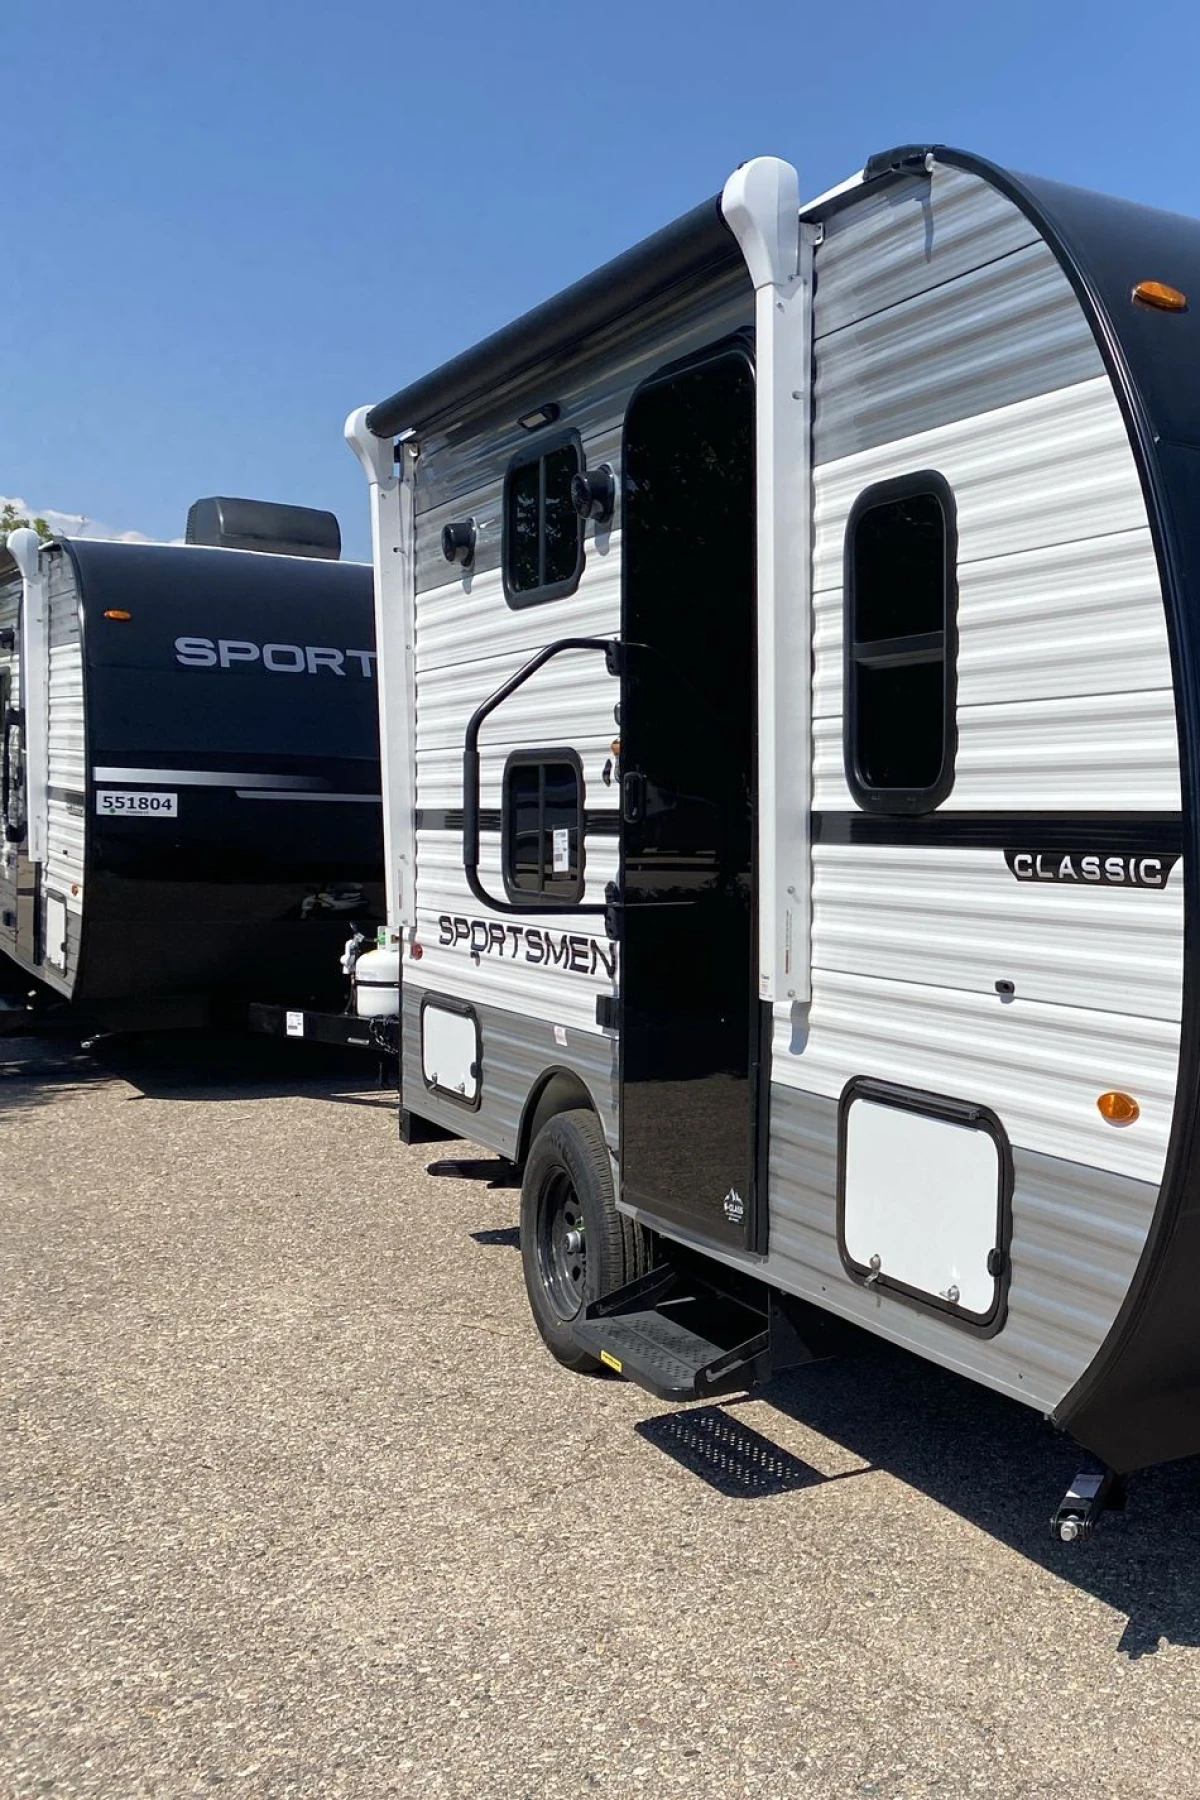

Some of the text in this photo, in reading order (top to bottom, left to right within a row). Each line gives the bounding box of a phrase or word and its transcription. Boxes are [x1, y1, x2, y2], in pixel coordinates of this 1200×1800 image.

[174, 637, 377, 678] SPORT
[102, 796, 172, 811] 551804
[1013, 854, 1162, 884] CLASSIC
[438, 915, 616, 979] SPORTSMEN
